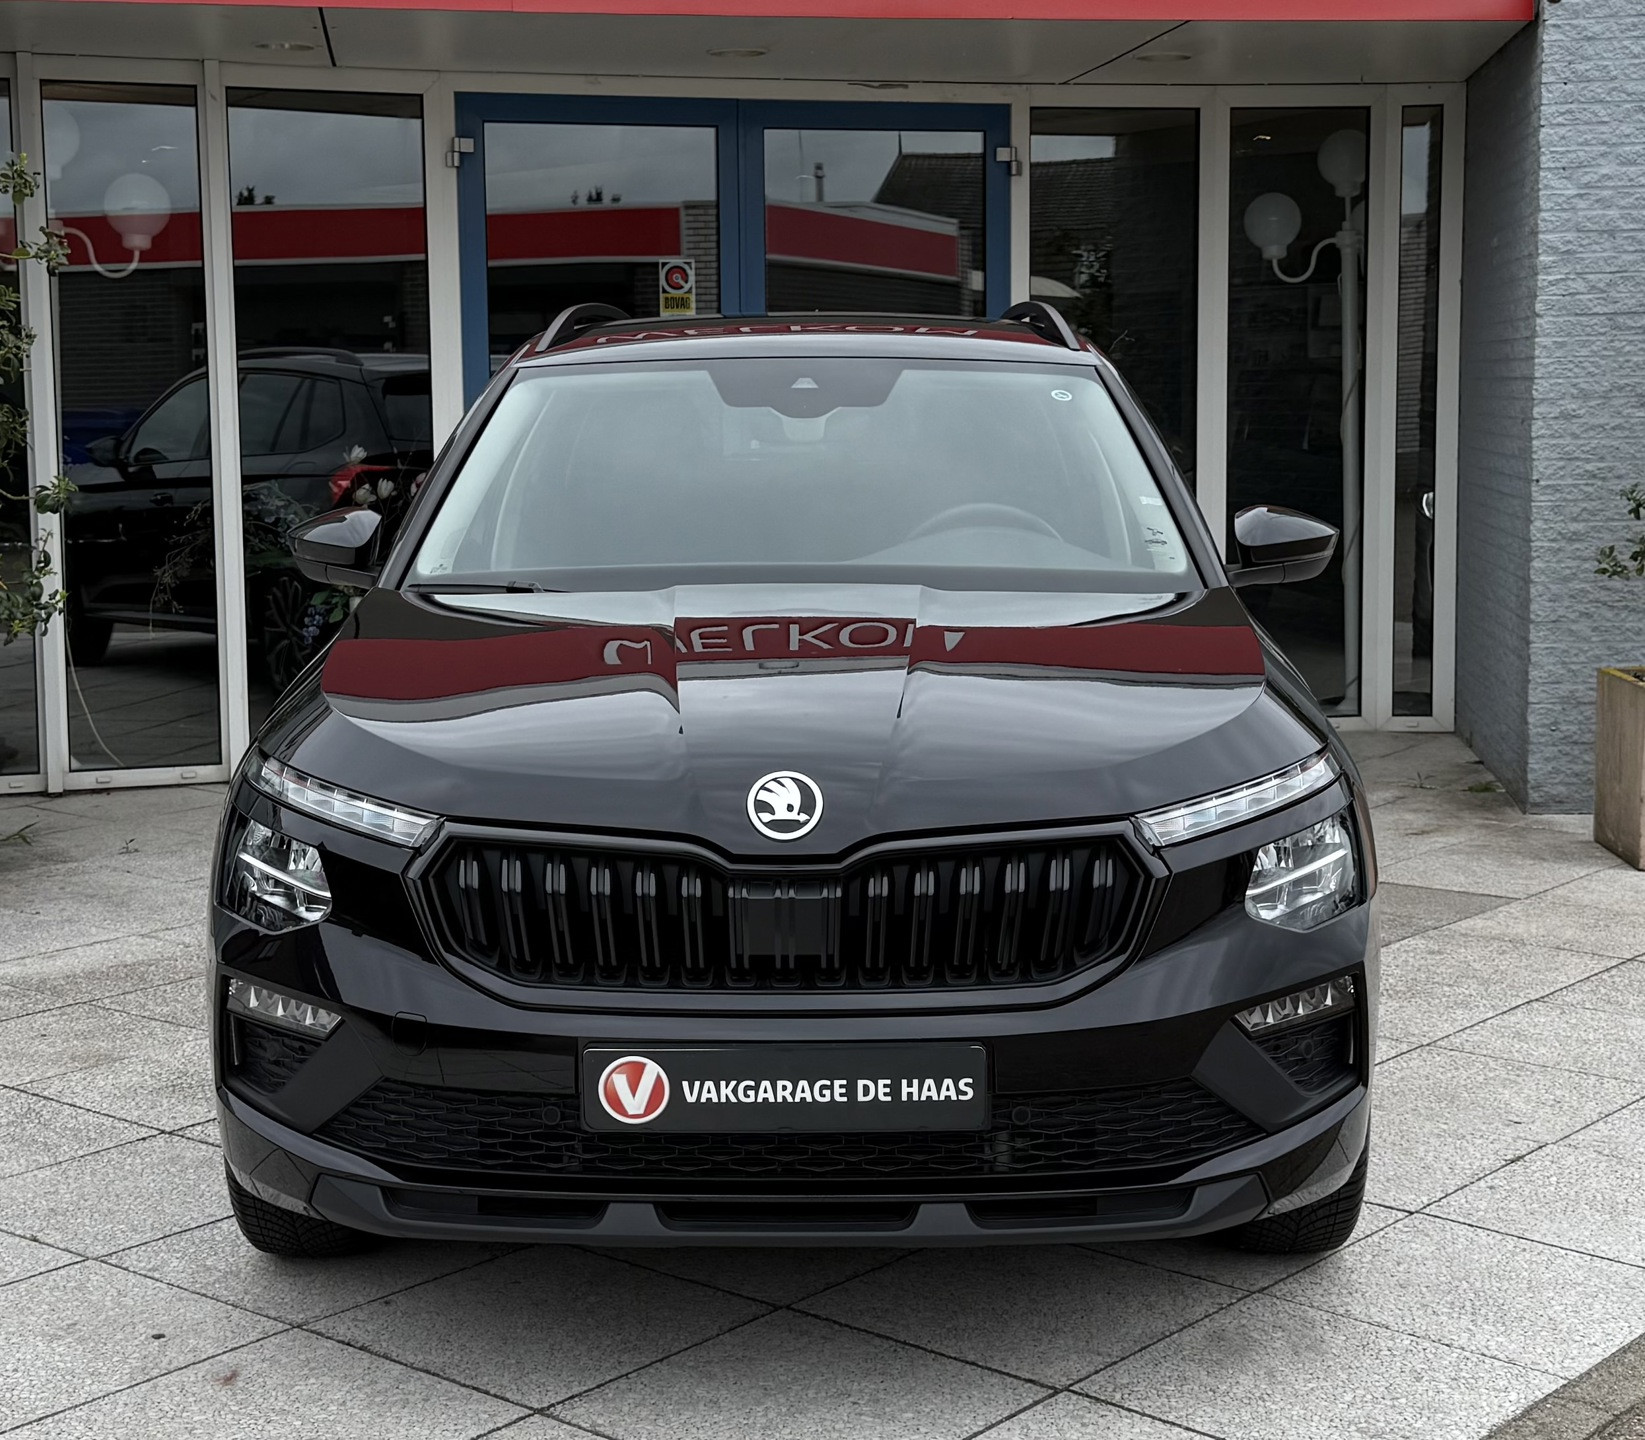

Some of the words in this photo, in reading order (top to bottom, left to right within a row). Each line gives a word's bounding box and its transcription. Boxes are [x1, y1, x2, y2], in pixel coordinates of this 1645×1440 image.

[664, 296, 691, 310] BOVAG
[681, 1079, 848, 1103] VAKGARAGE
[857, 1079, 892, 1101] DE
[901, 1077, 974, 1101] HAAS
